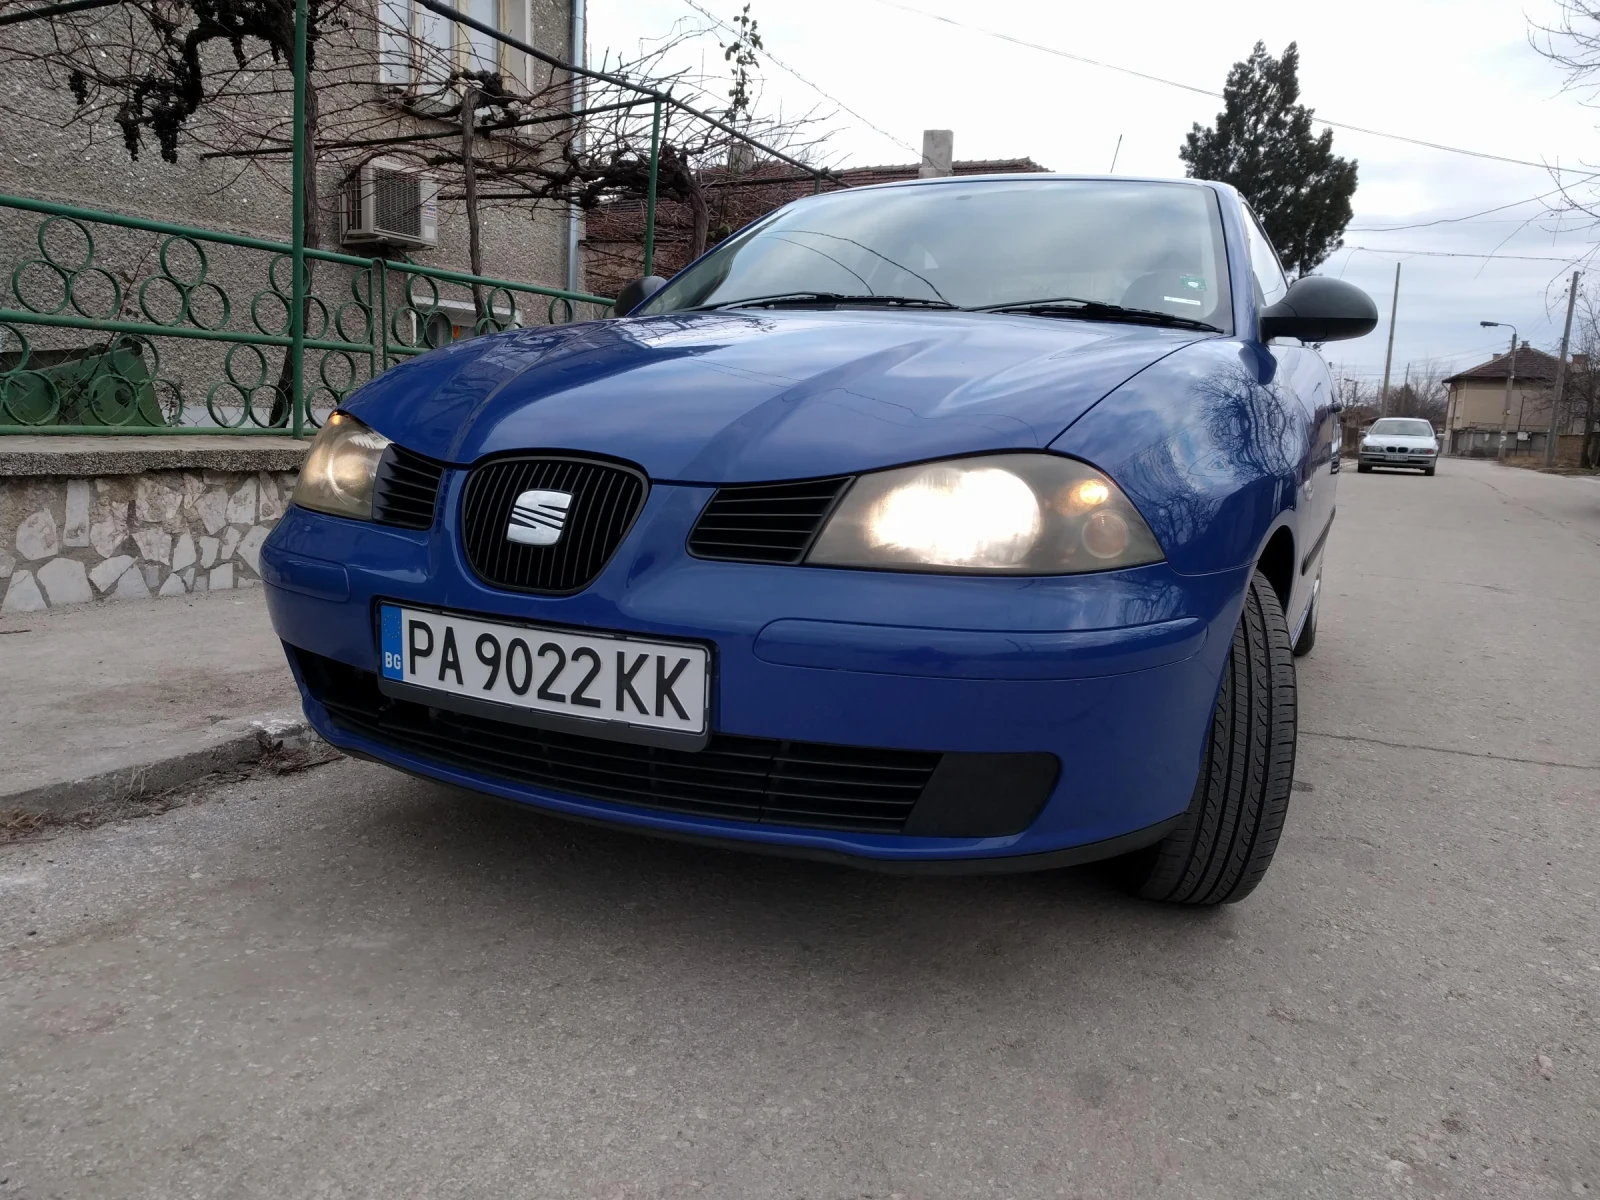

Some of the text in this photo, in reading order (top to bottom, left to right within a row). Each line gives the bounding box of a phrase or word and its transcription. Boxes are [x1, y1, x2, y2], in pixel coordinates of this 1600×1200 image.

[385, 651, 402, 670] BG
[408, 619, 691, 721] PA 9022 KK
